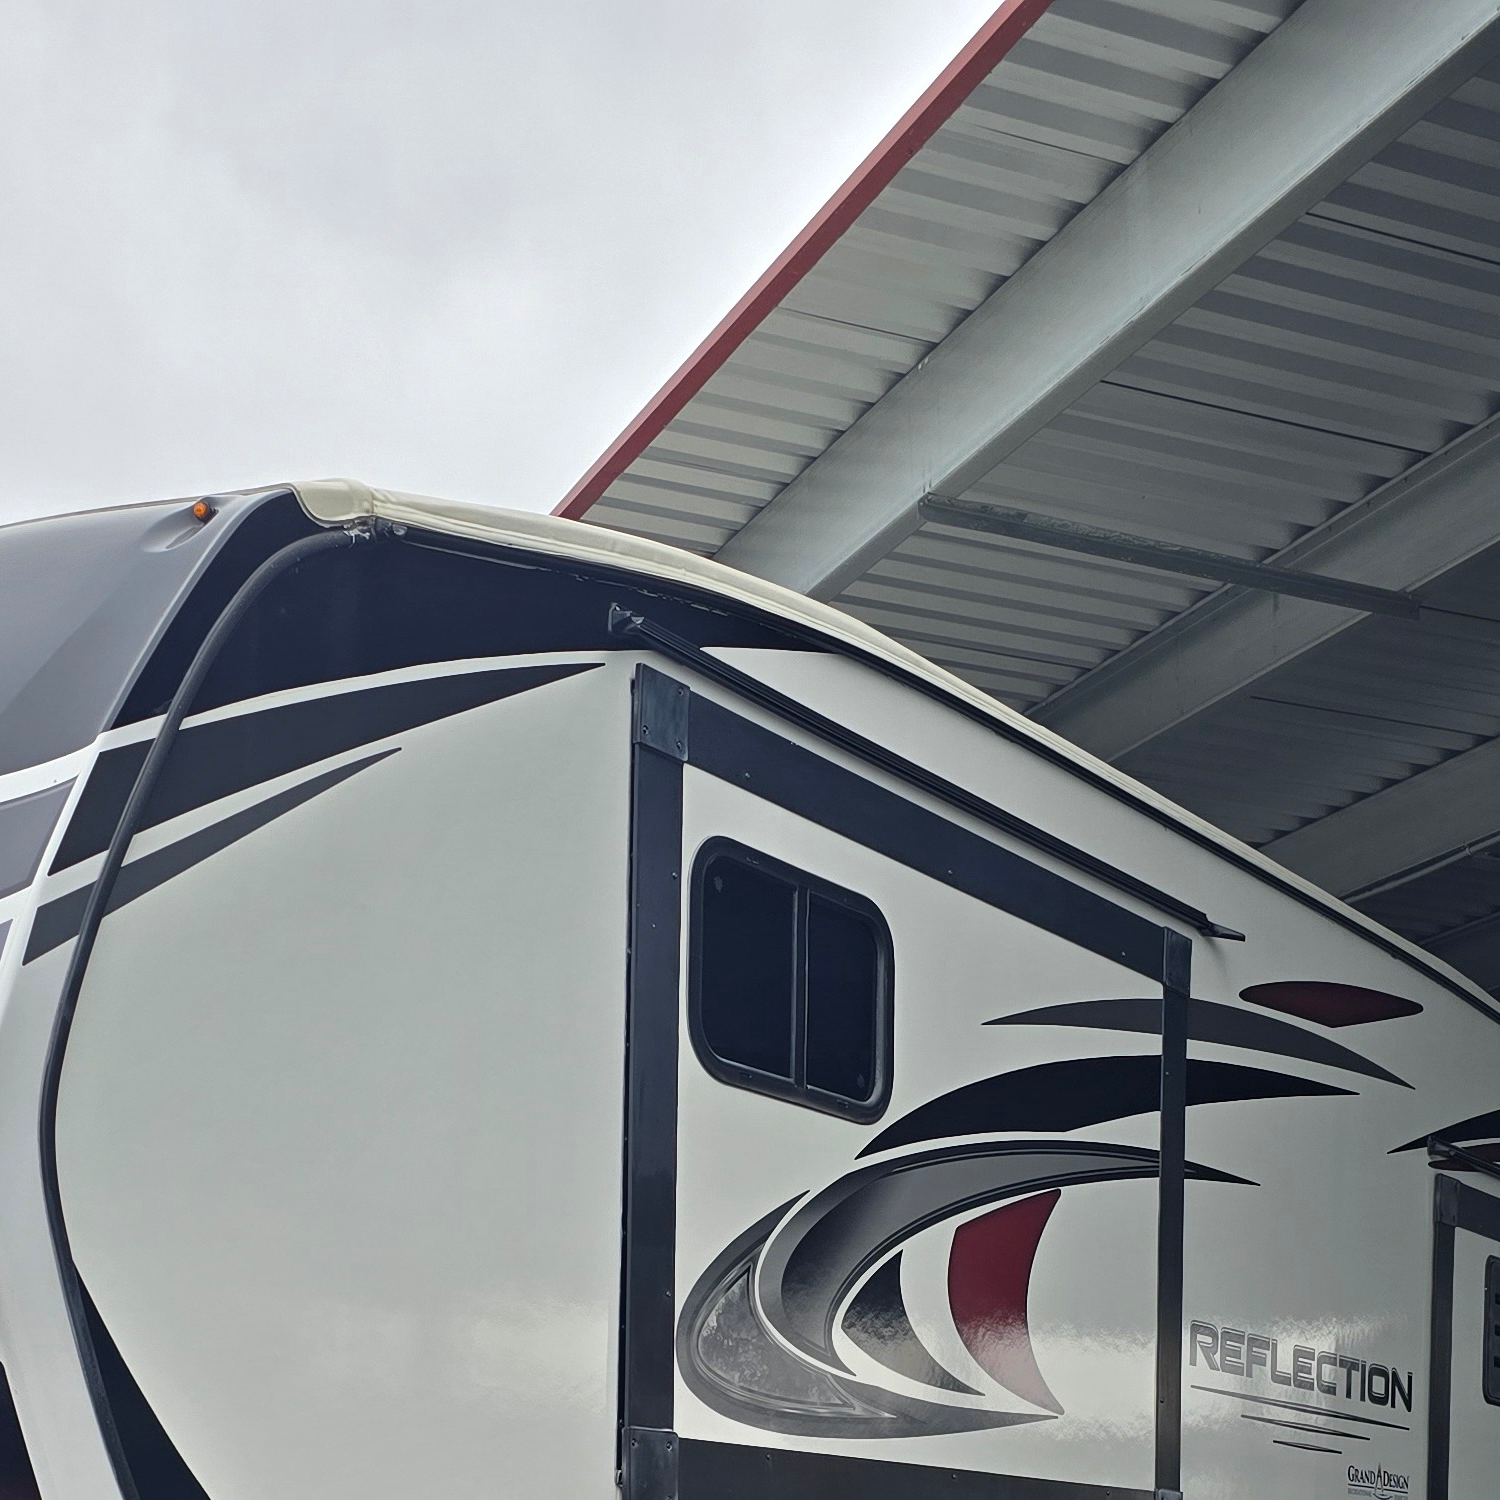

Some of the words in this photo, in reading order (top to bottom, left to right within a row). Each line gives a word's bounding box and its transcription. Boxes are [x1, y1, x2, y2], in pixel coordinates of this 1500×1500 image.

[1189, 1319, 1414, 1413] REFLECTION
[1348, 1465, 1376, 1485] GRAND
[1383, 1470, 1410, 1489] DESIGN
